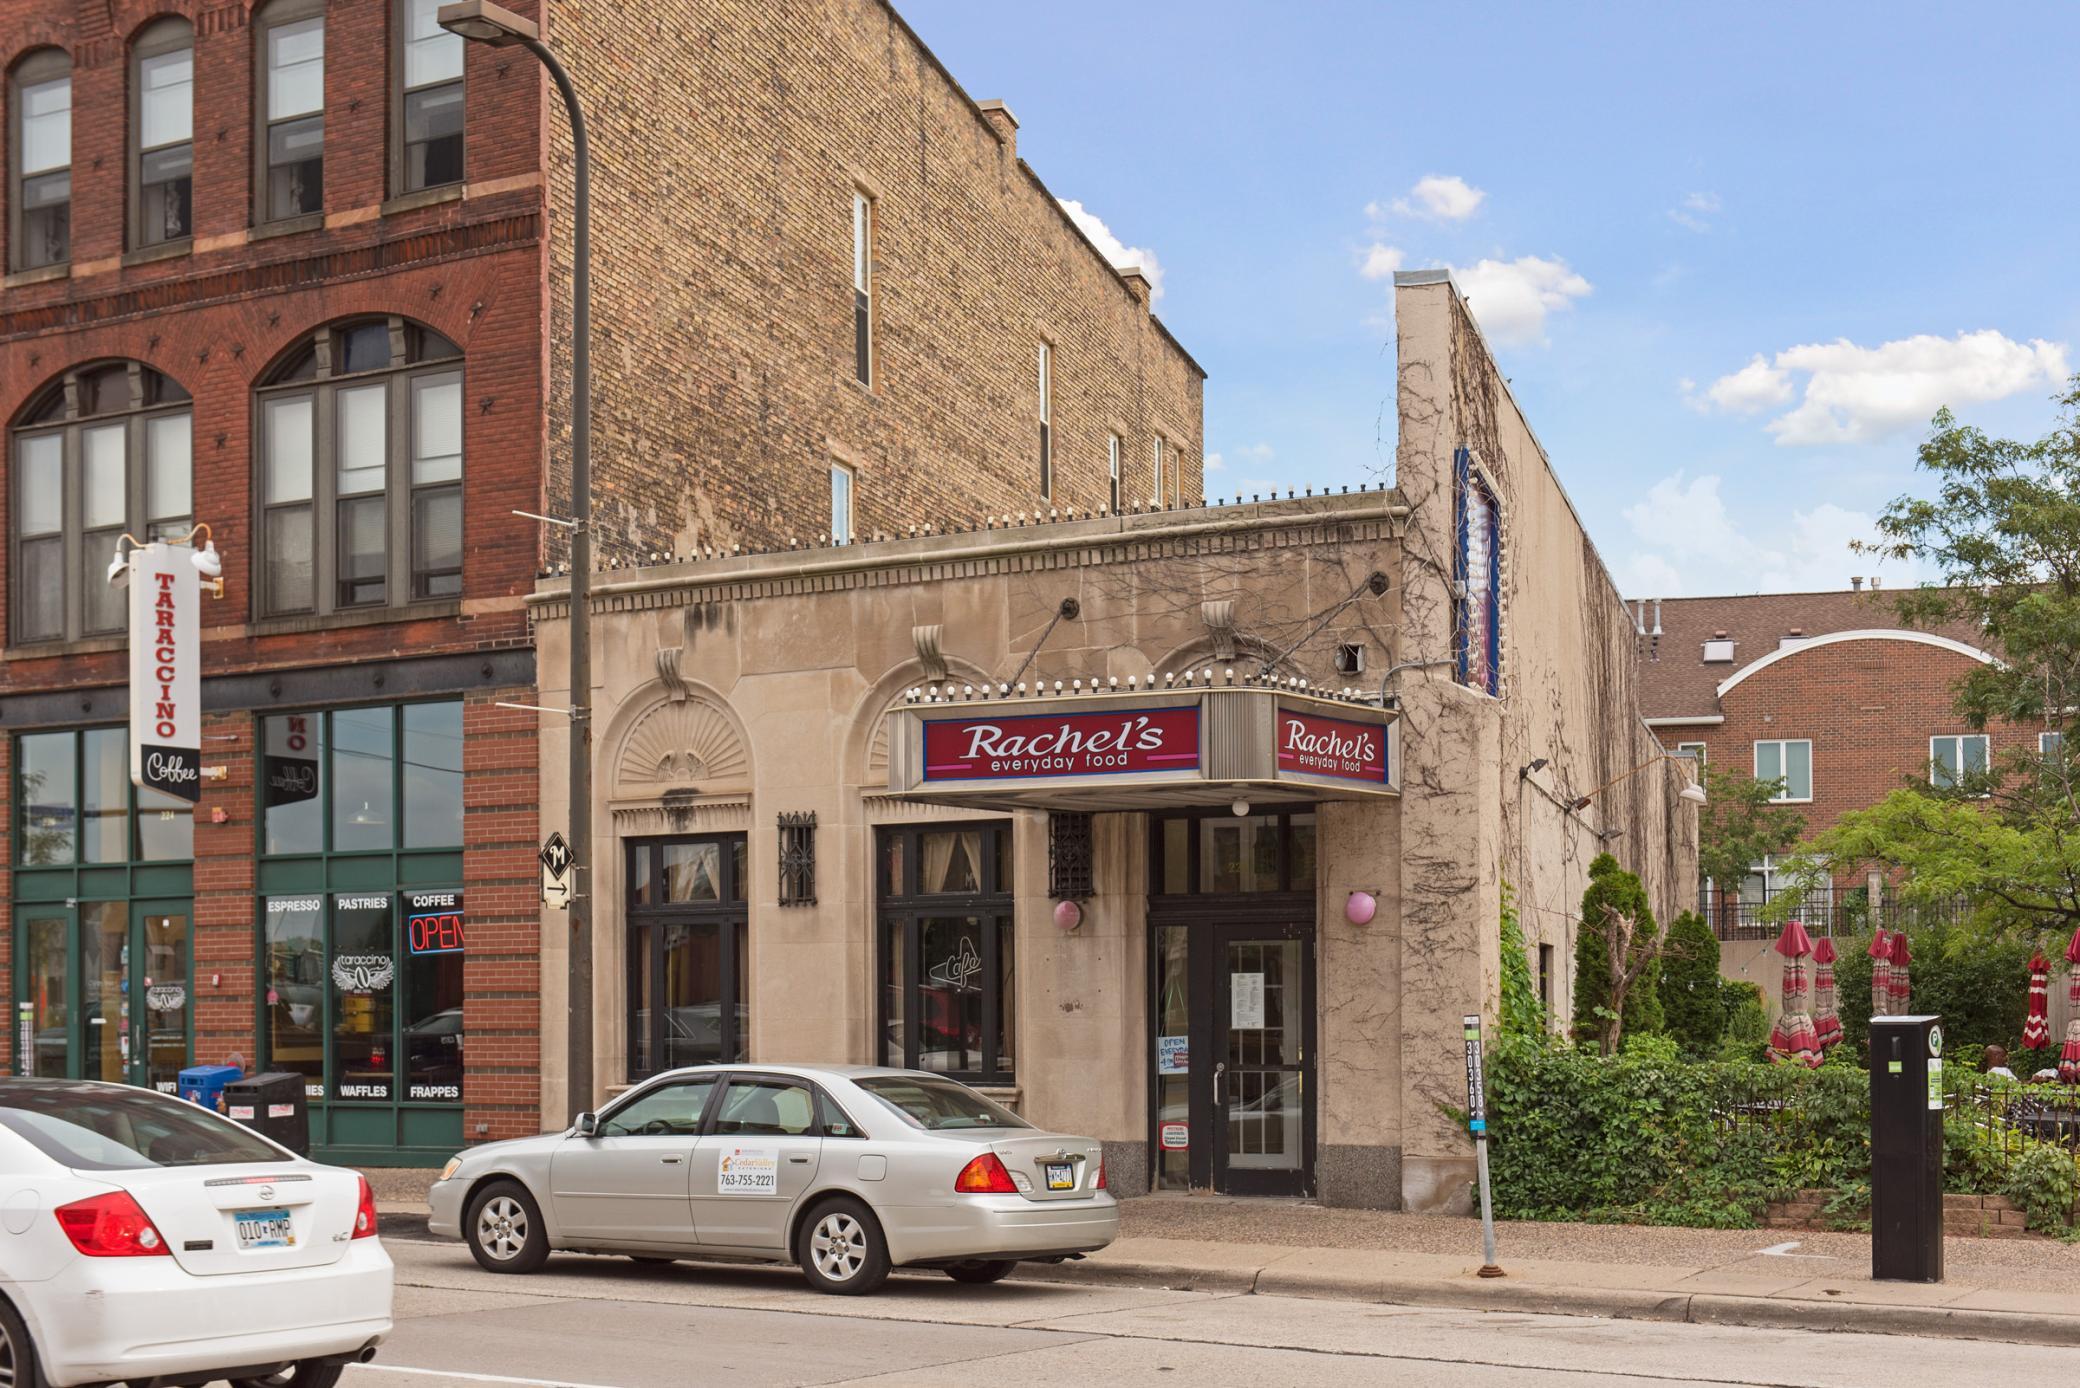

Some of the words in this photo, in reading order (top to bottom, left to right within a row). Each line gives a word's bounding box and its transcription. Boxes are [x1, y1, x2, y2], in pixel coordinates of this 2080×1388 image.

[155, 572, 176, 738] TARACCINO
[959, 716, 1164, 759] Rachel's
[1284, 719, 1375, 761] Rachel's
[147, 752, 198, 783] Coffee
[991, 755, 1075, 773] everyday
[1086, 752, 1128, 768] food
[1299, 754, 1338, 771] everyday
[1341, 758, 1361, 772] food
[549, 845, 565, 868] M
[268, 899, 320, 912] ESPRESSO
[338, 897, 388, 910] PASTRIES
[412, 894, 455, 907] COFFEE
[411, 915, 464, 950] OPEN
[341, 954, 386, 965] taraccino
[1466, 1041, 1476, 1108] 30360
[156, 1081, 177, 1093] WIFI
[340, 1085, 387, 1097] WAFFLES
[410, 1086, 459, 1098] FRAPPES
[721, 1174, 774, 1186] 763-755-2221
[238, 1220, 261, 1240] 010
